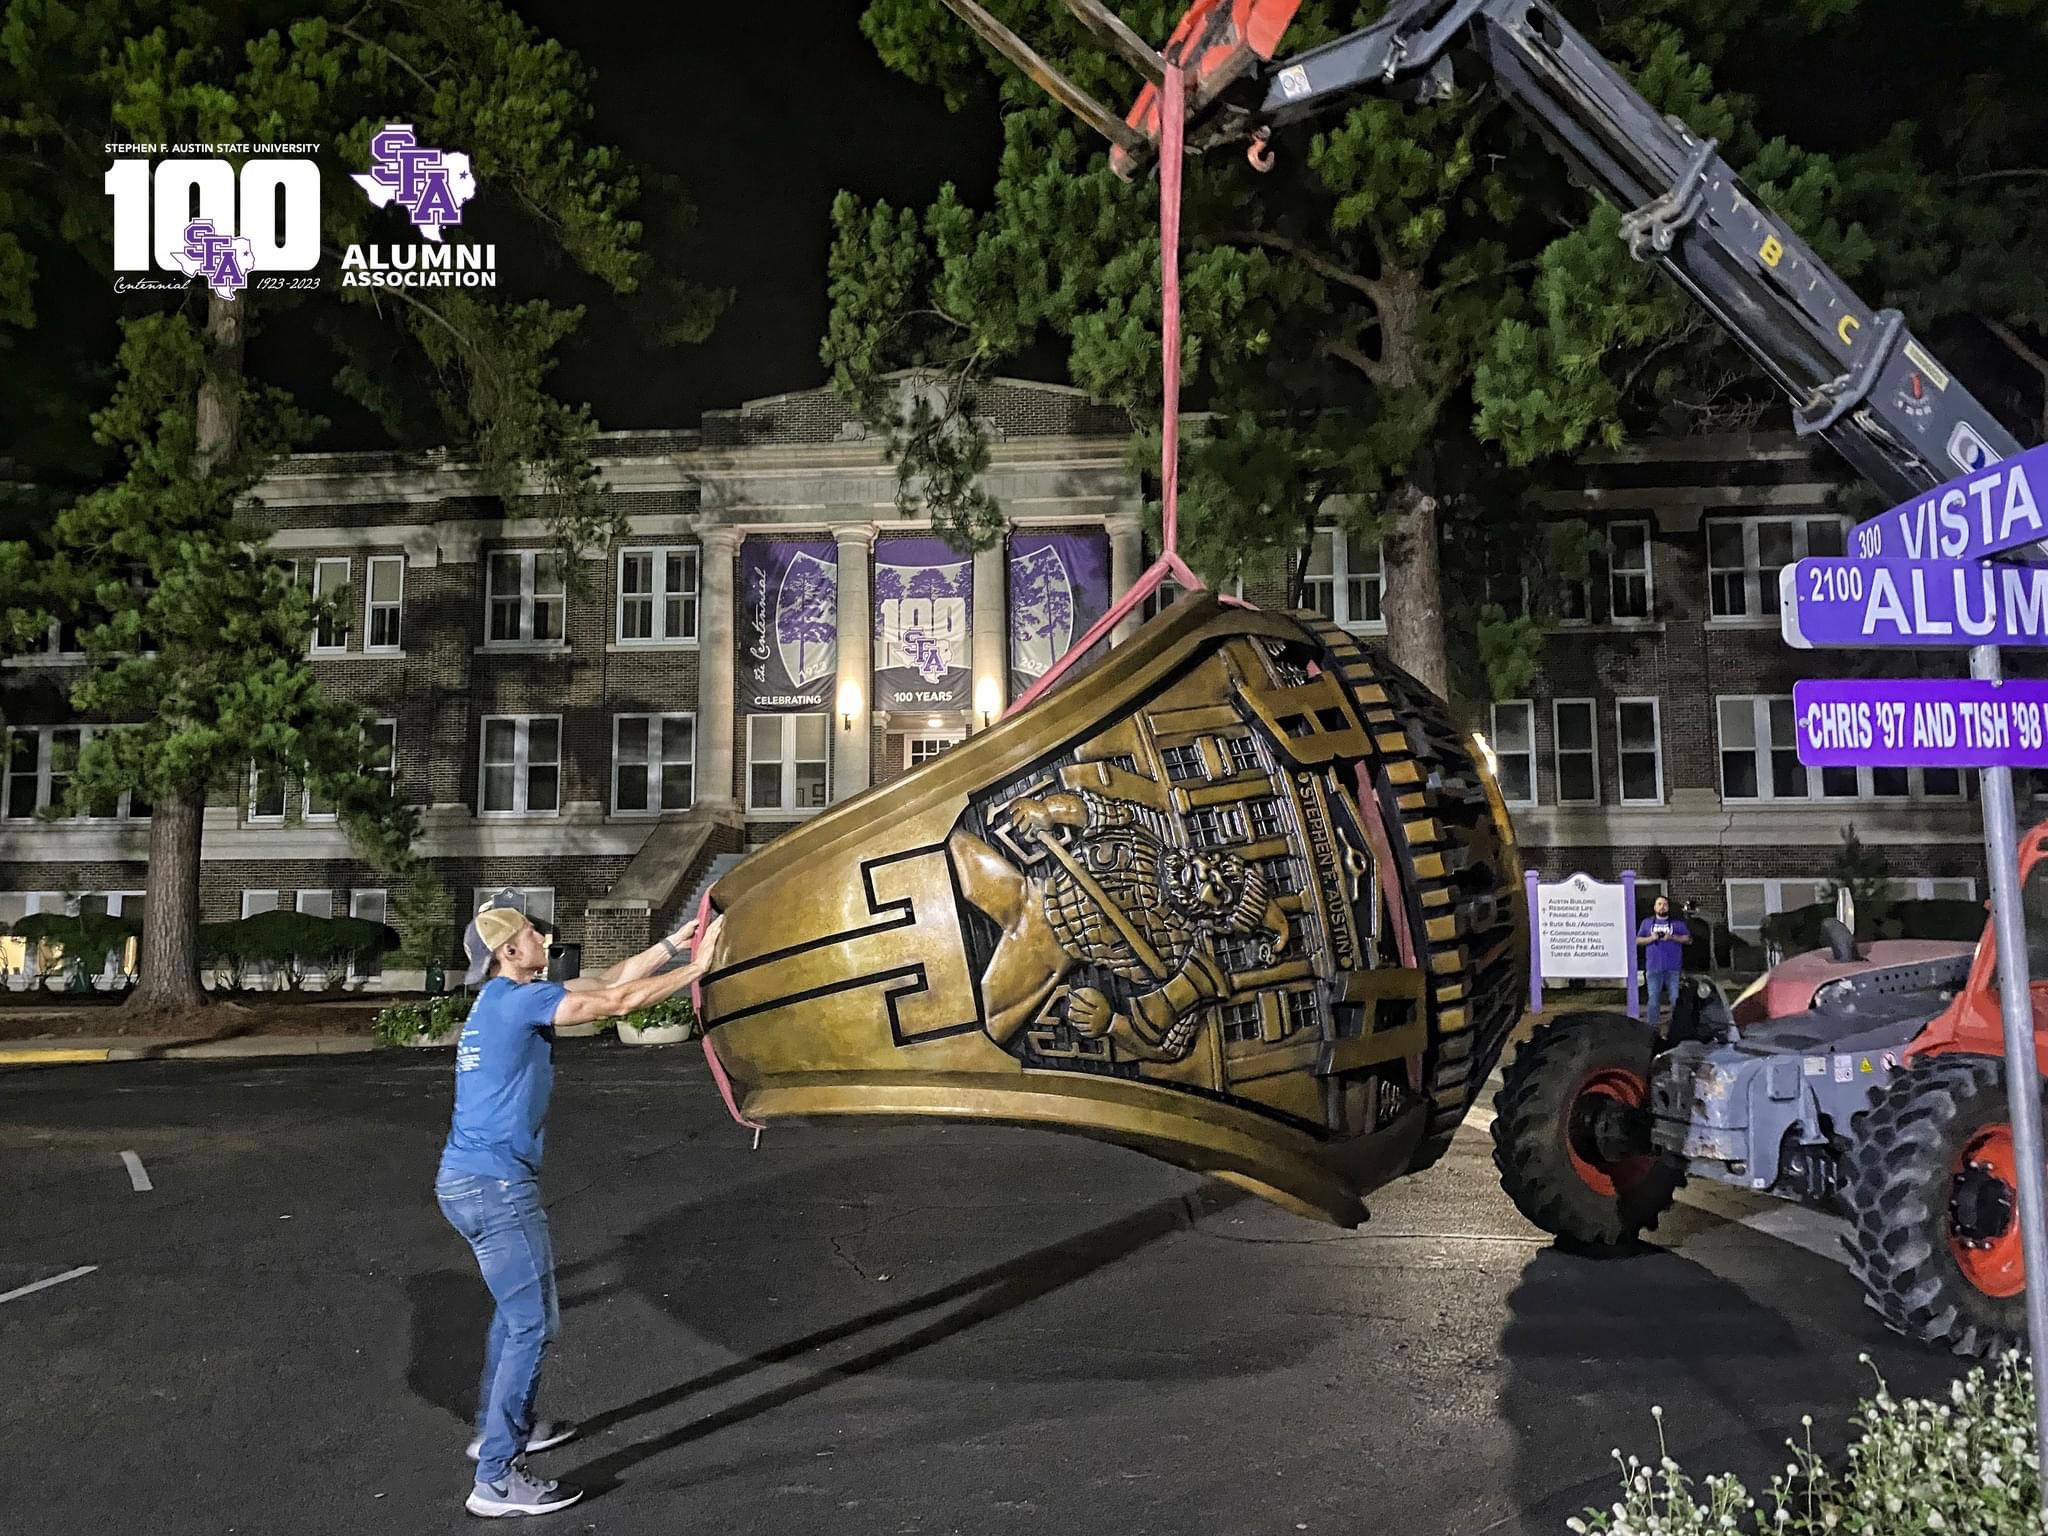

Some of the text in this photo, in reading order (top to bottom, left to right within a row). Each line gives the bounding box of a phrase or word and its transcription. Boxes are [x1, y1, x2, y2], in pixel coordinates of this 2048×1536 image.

[1858, 464, 2043, 560] 300 VISTA
[750, 566, 771, 661] Centennial
[1809, 567, 2048, 636] 2100 ALUM
[903, 629, 948, 673] SFA
[753, 695, 823, 706] CELEBRATING
[894, 690, 953, 703] 100 YEARS
[1806, 702, 1873, 749] CHRIS
[1876, 701, 1906, 749] '97
[1913, 702, 1957, 749] AND
[1959, 701, 2011, 749] TISH
[2012, 702, 2043, 749] '98
[1300, 787, 1333, 867] STEPHEN
[1326, 888, 1352, 954] AUSTIN
